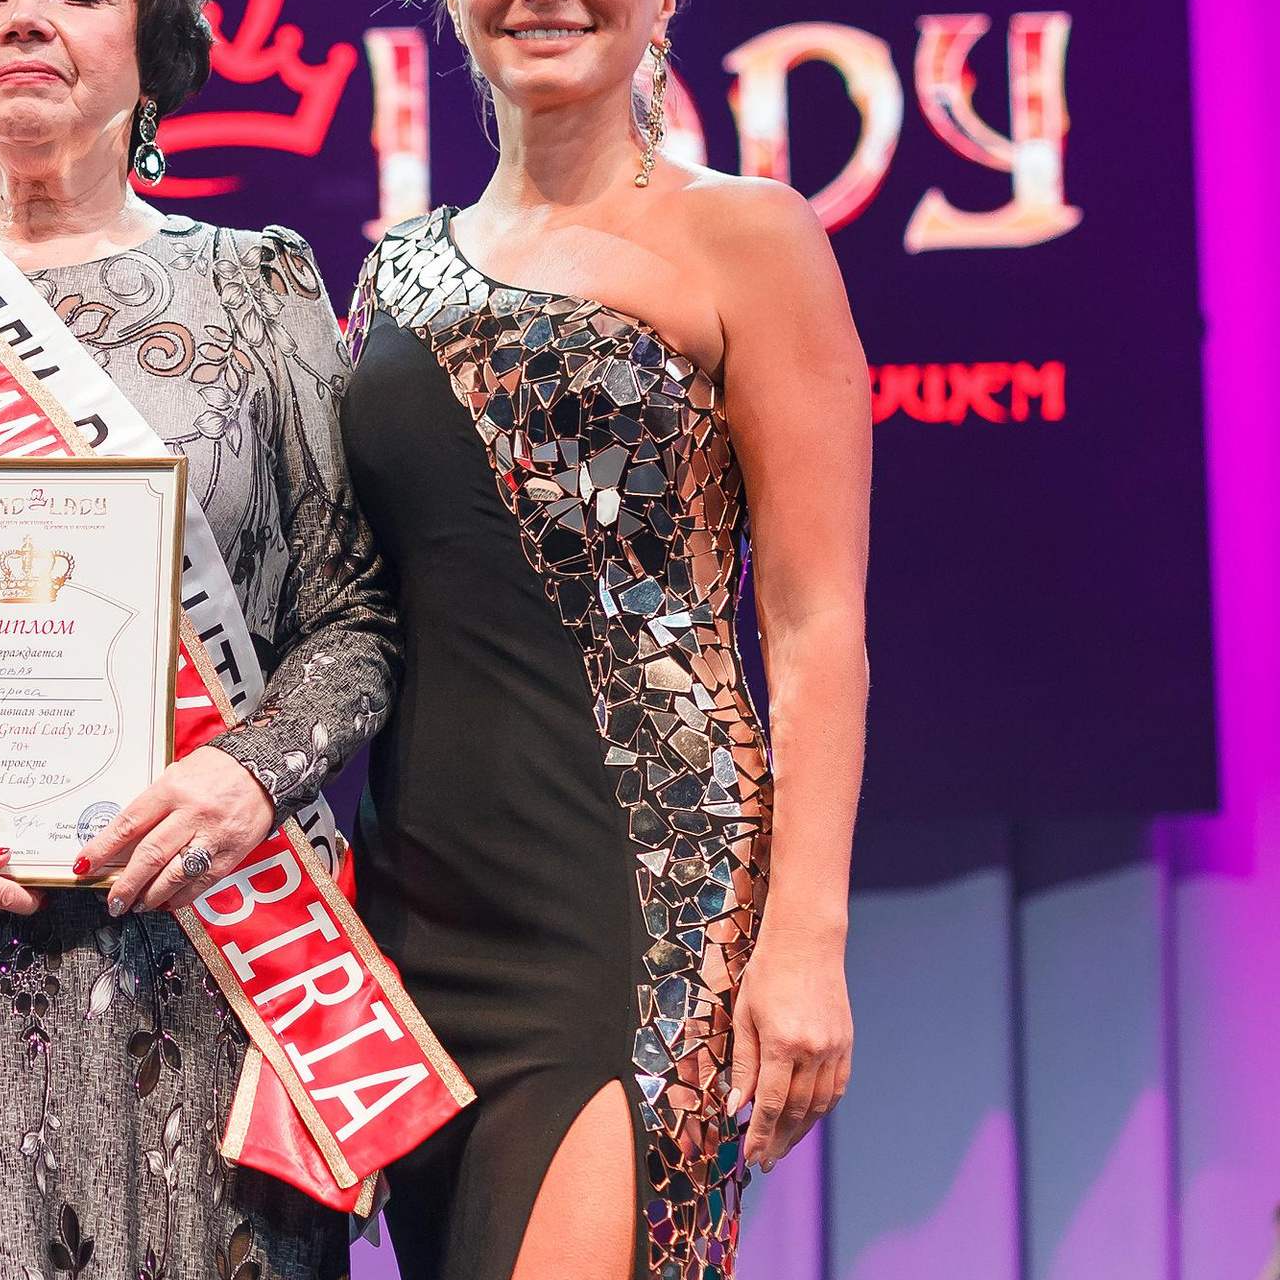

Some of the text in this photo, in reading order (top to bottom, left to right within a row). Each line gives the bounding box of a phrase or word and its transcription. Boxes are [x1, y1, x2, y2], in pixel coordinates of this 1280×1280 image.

[361, 11, 1084, 253] LDY
[49, 497, 107, 516] LADY
[38, 708, 76, 717] звание
[41, 721, 74, 739] Lady
[77, 723, 115, 736] 2021»
[10, 741, 30, 751] 70+
[1, 758, 47, 770] проекте
[8, 773, 37, 787] Lady
[39, 774, 72, 785] 2021»
